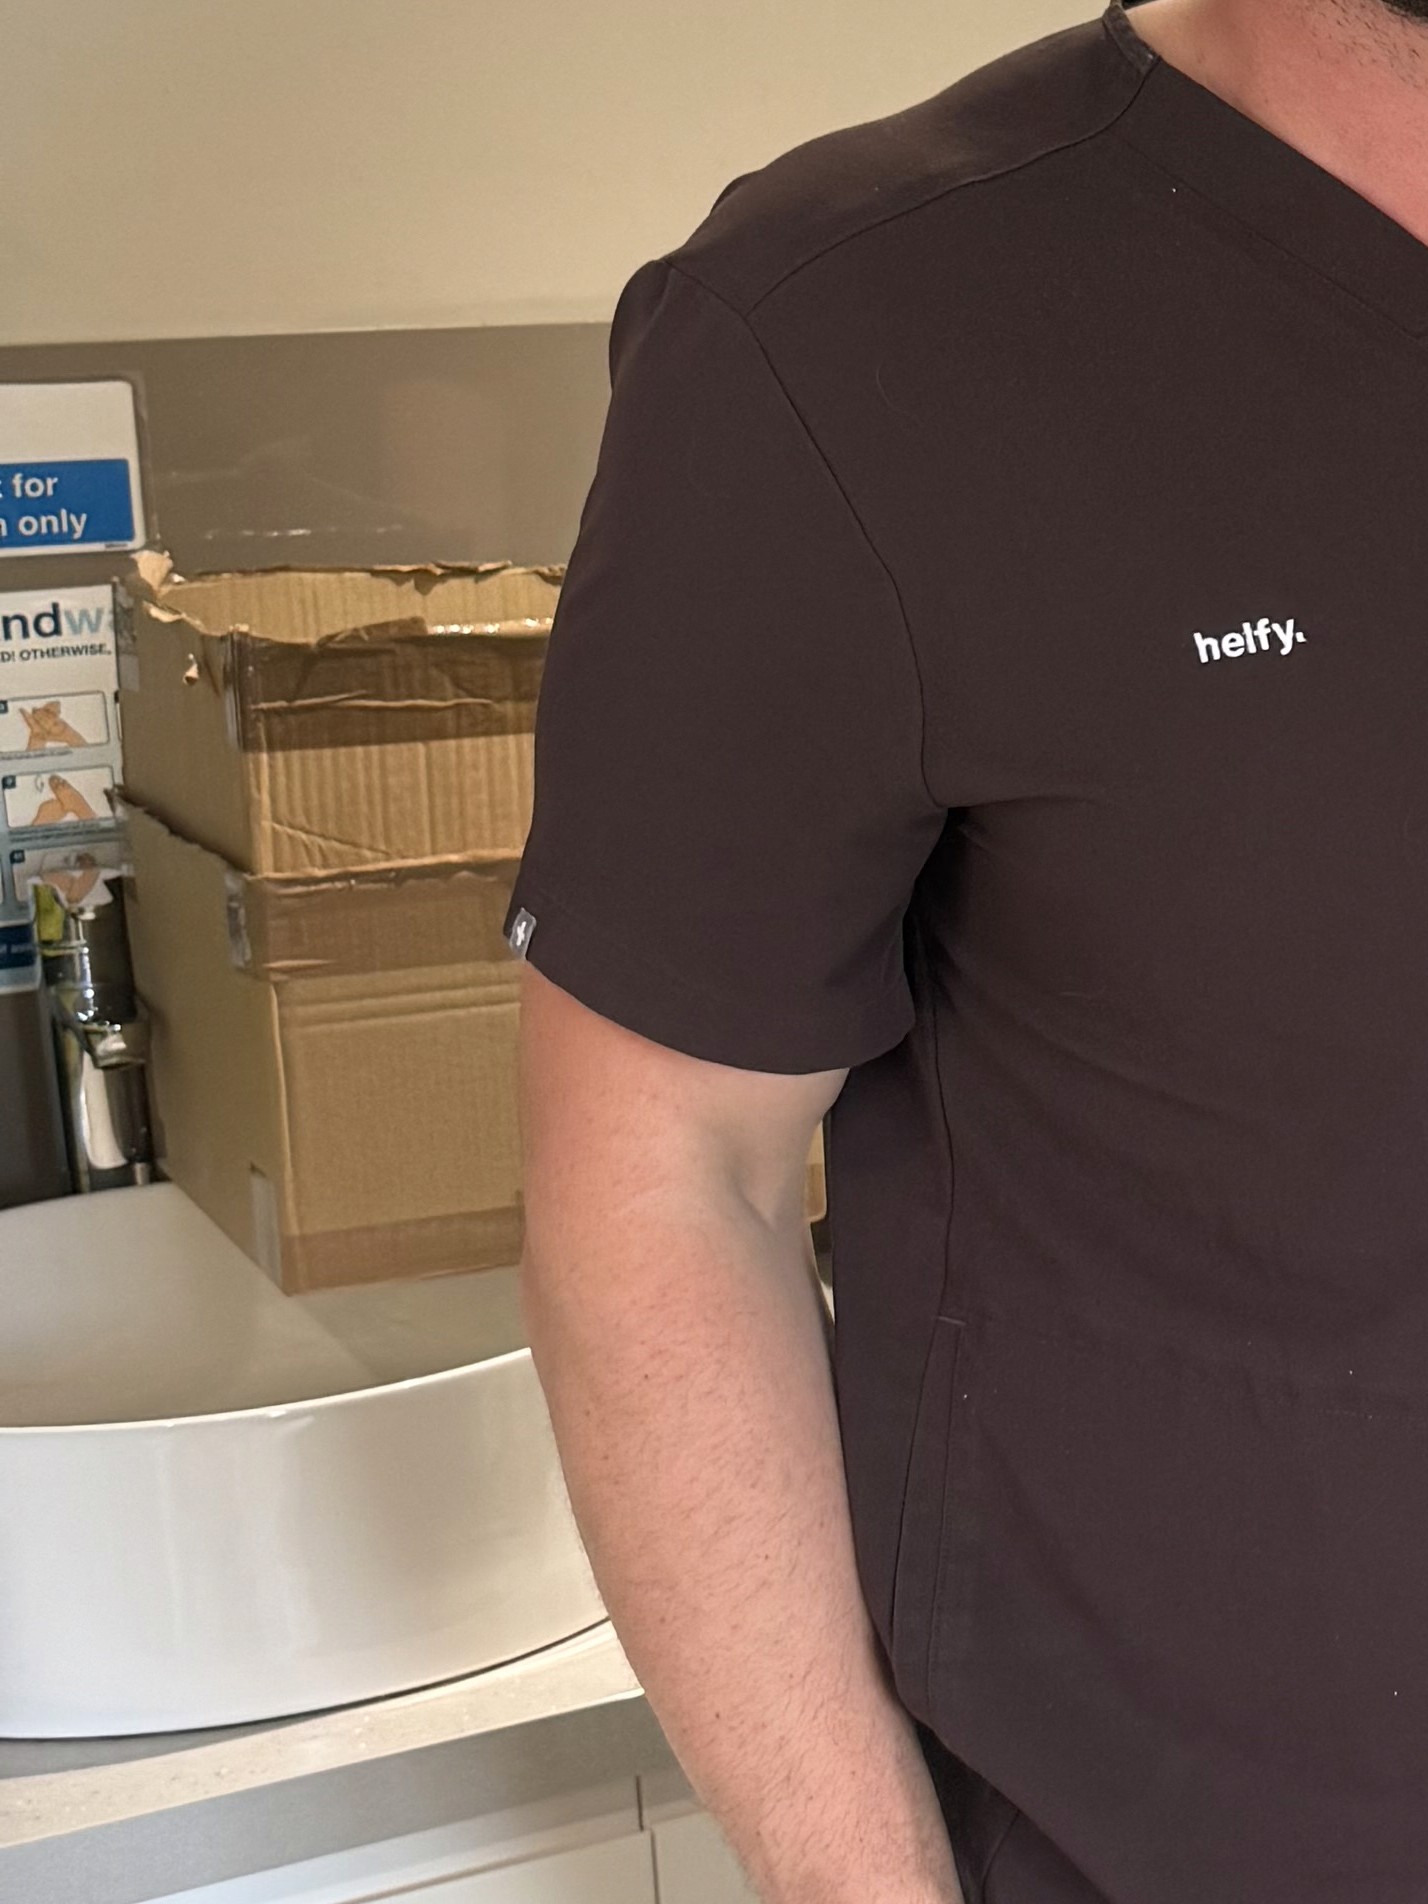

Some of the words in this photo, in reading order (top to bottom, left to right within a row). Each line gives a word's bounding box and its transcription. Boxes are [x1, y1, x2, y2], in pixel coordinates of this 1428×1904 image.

[12, 472, 58, 498] for
[18, 508, 88, 540] only
[19, 643, 112, 662] OTHERWISE.
[1193, 617, 1307, 664] helfy.
